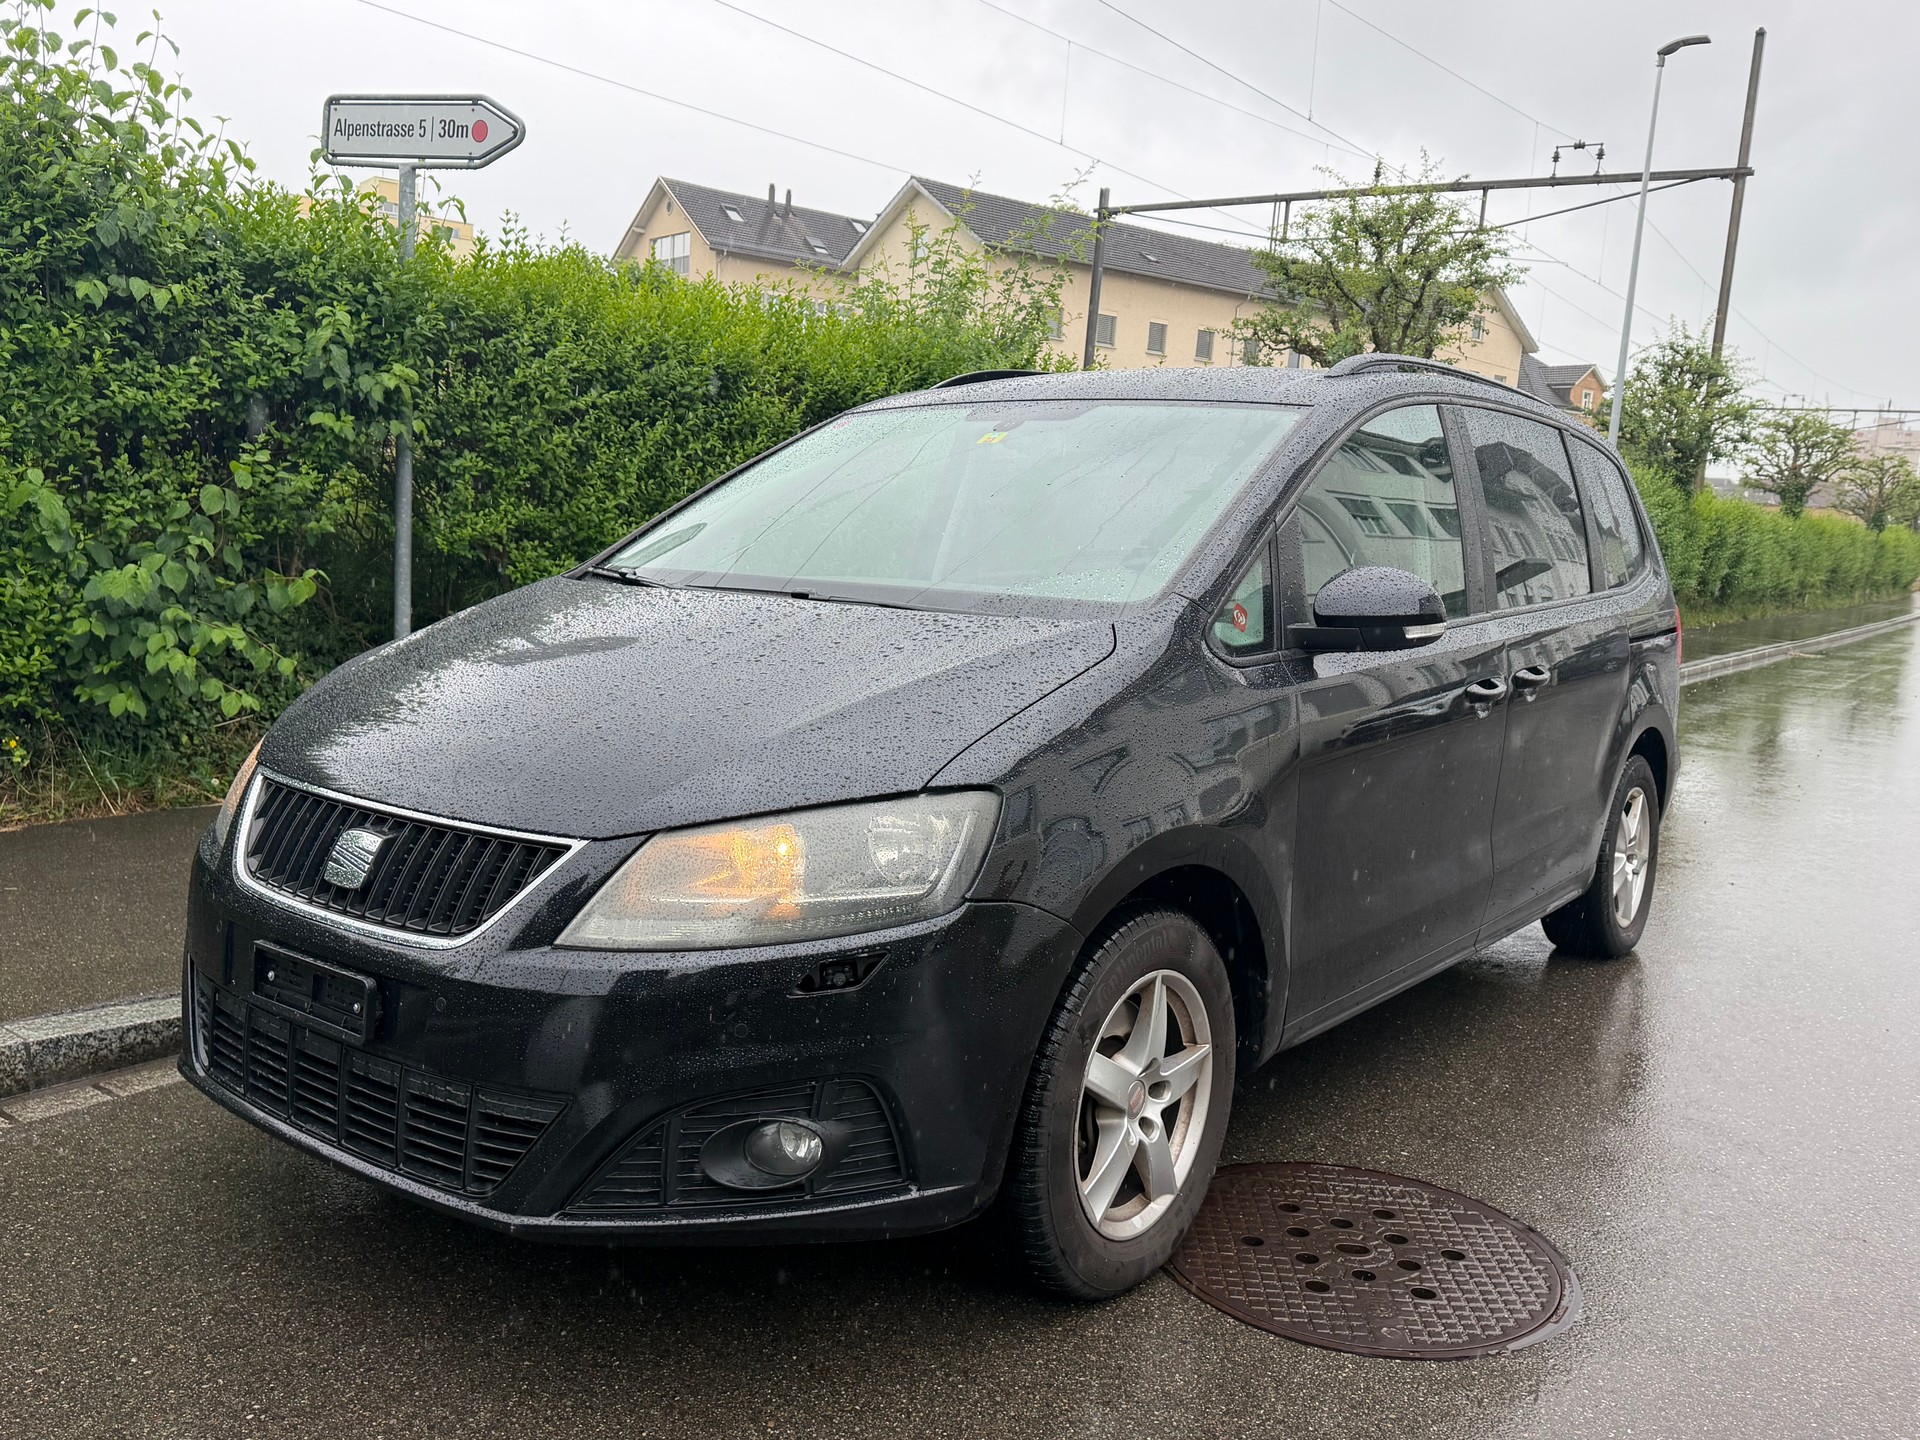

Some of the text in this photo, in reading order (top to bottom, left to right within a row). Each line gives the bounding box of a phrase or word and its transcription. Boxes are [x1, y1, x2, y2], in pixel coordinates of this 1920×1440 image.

[334, 118, 469, 141] Alpenstrasse 5 30m
